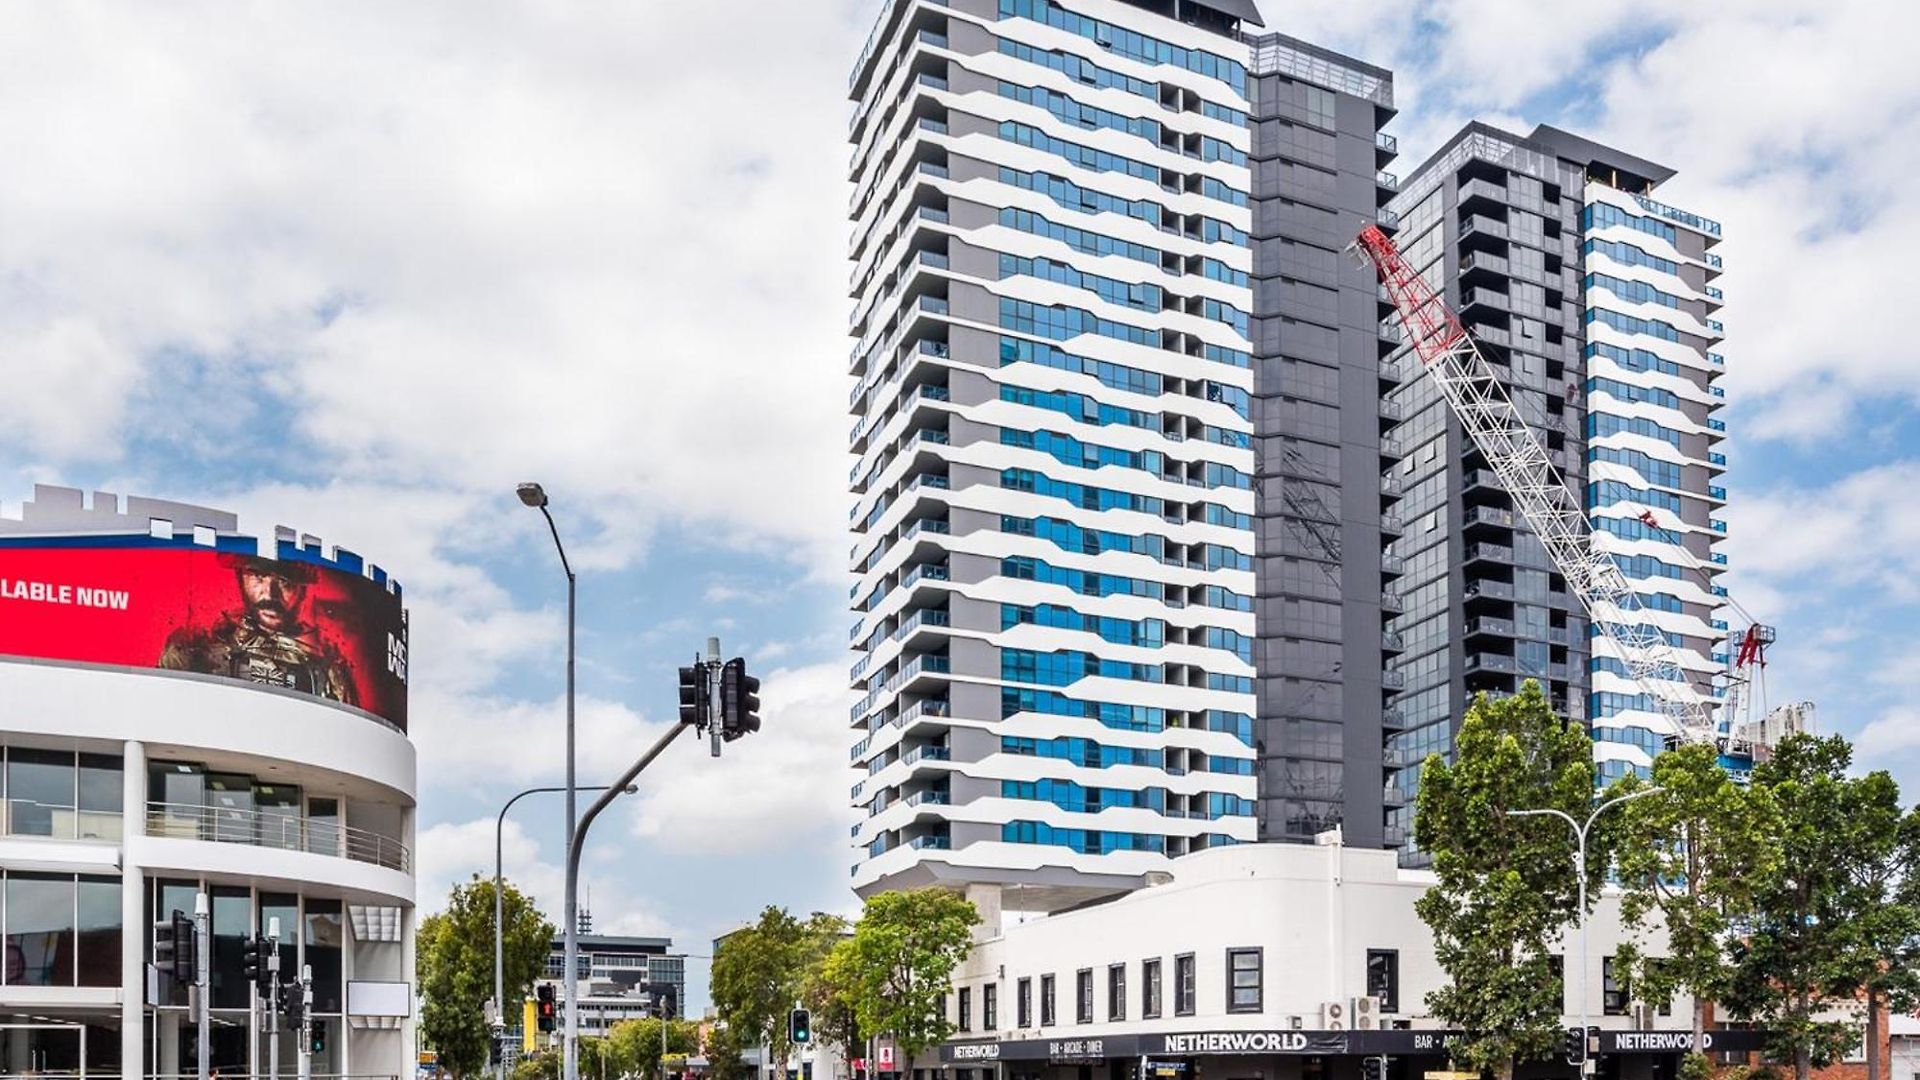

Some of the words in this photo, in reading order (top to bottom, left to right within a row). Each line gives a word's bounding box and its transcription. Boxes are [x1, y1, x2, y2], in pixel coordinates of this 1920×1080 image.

[0, 578, 72, 604] LABLE
[77, 587, 129, 610] NOW
[1165, 1033, 1308, 1051] NETHERWORLD
[1414, 1034, 1433, 1049] BAR
[1616, 1033, 1713, 1050] NETHERWORD
[954, 1044, 1000, 1059] NETHERWORLD
